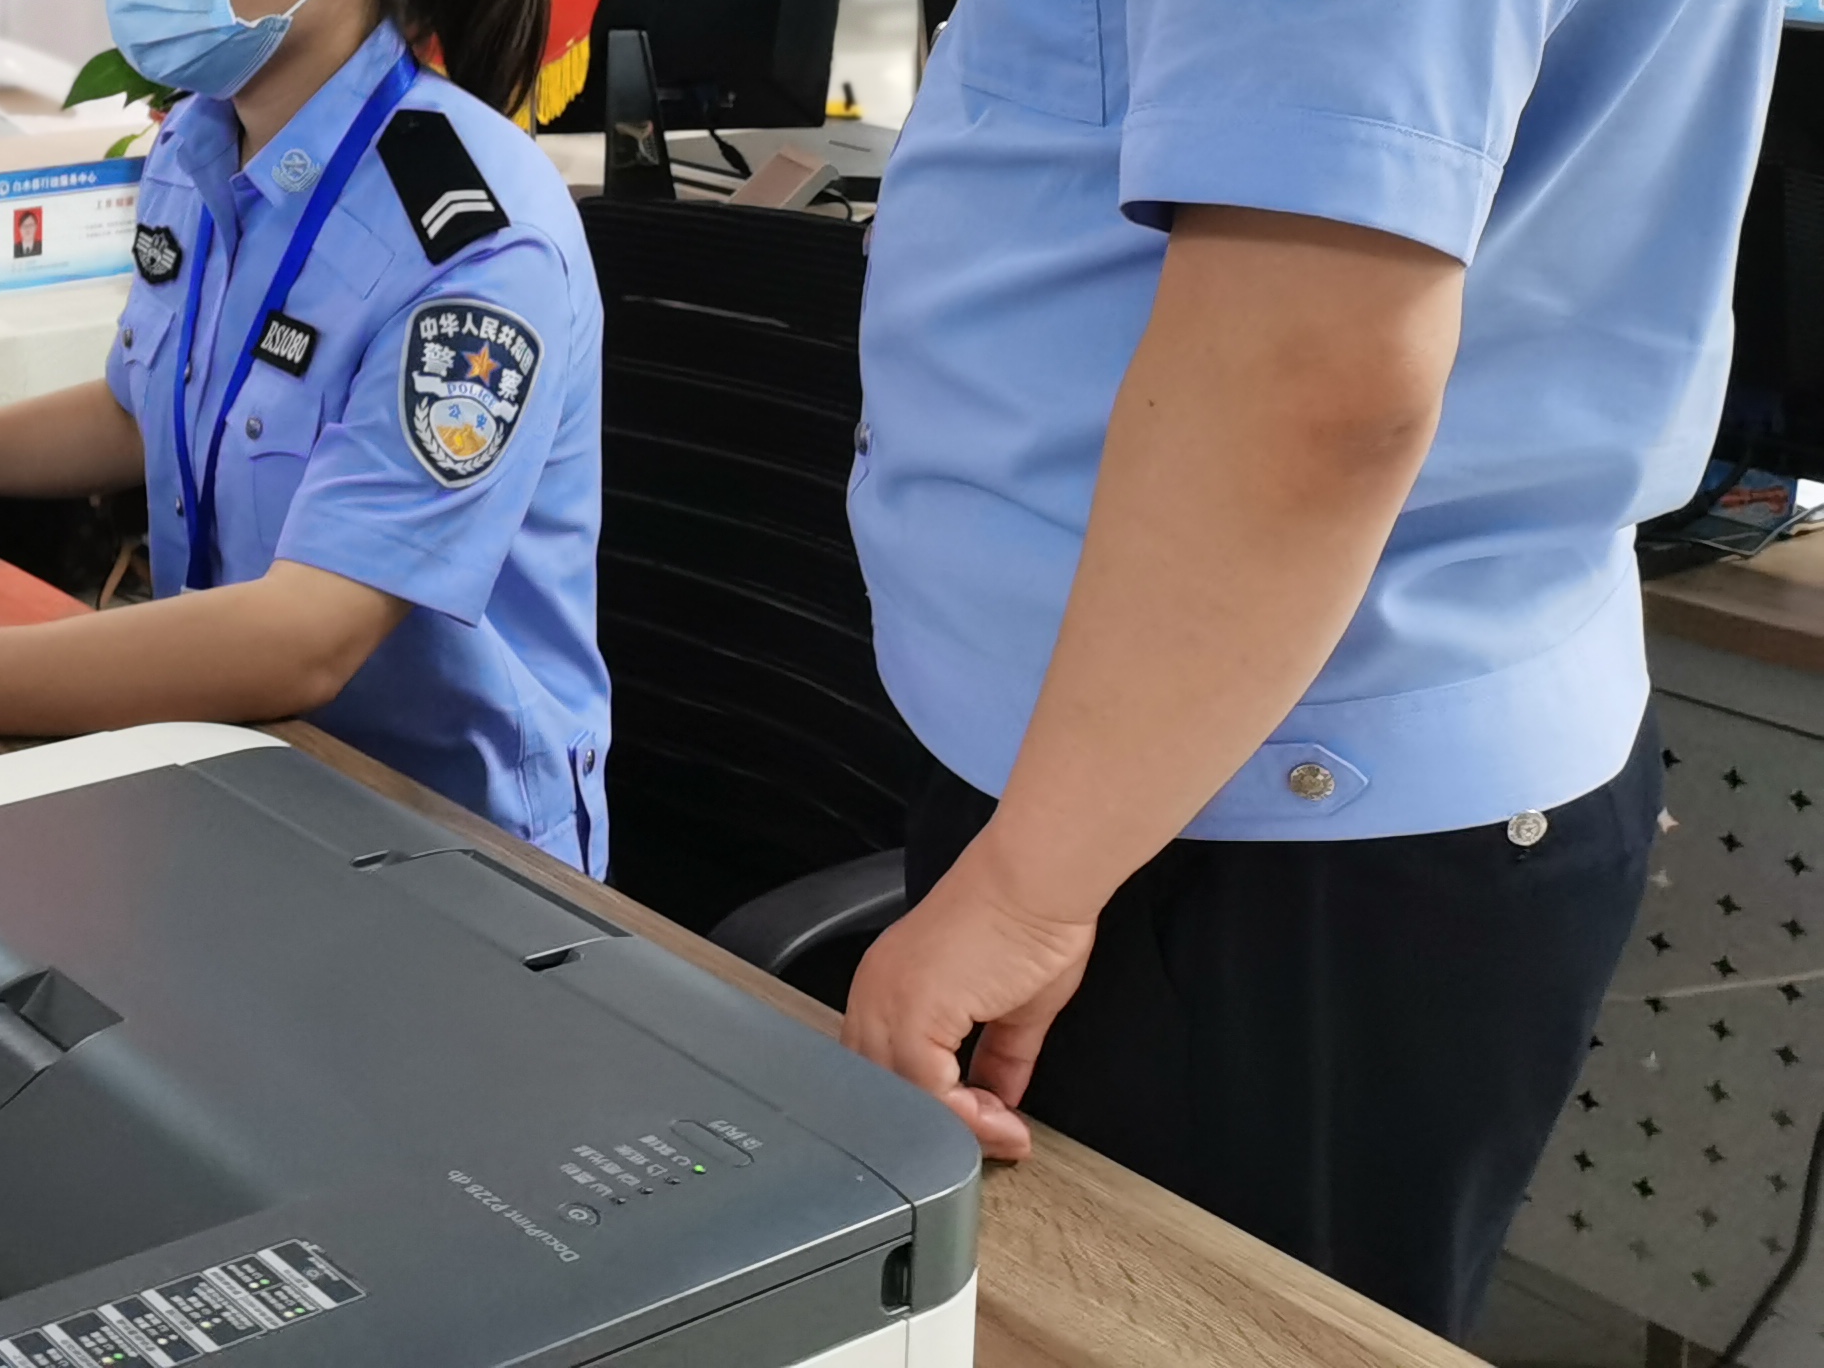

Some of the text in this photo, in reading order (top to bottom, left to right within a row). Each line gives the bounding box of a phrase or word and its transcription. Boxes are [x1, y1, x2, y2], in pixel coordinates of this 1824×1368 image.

[260, 320, 310, 364] BS1080
[419, 312, 534, 376] 中华人民共和国
[446, 382, 497, 409] POLICE
[448, 1169, 580, 1262] DocuPrint P228 db
